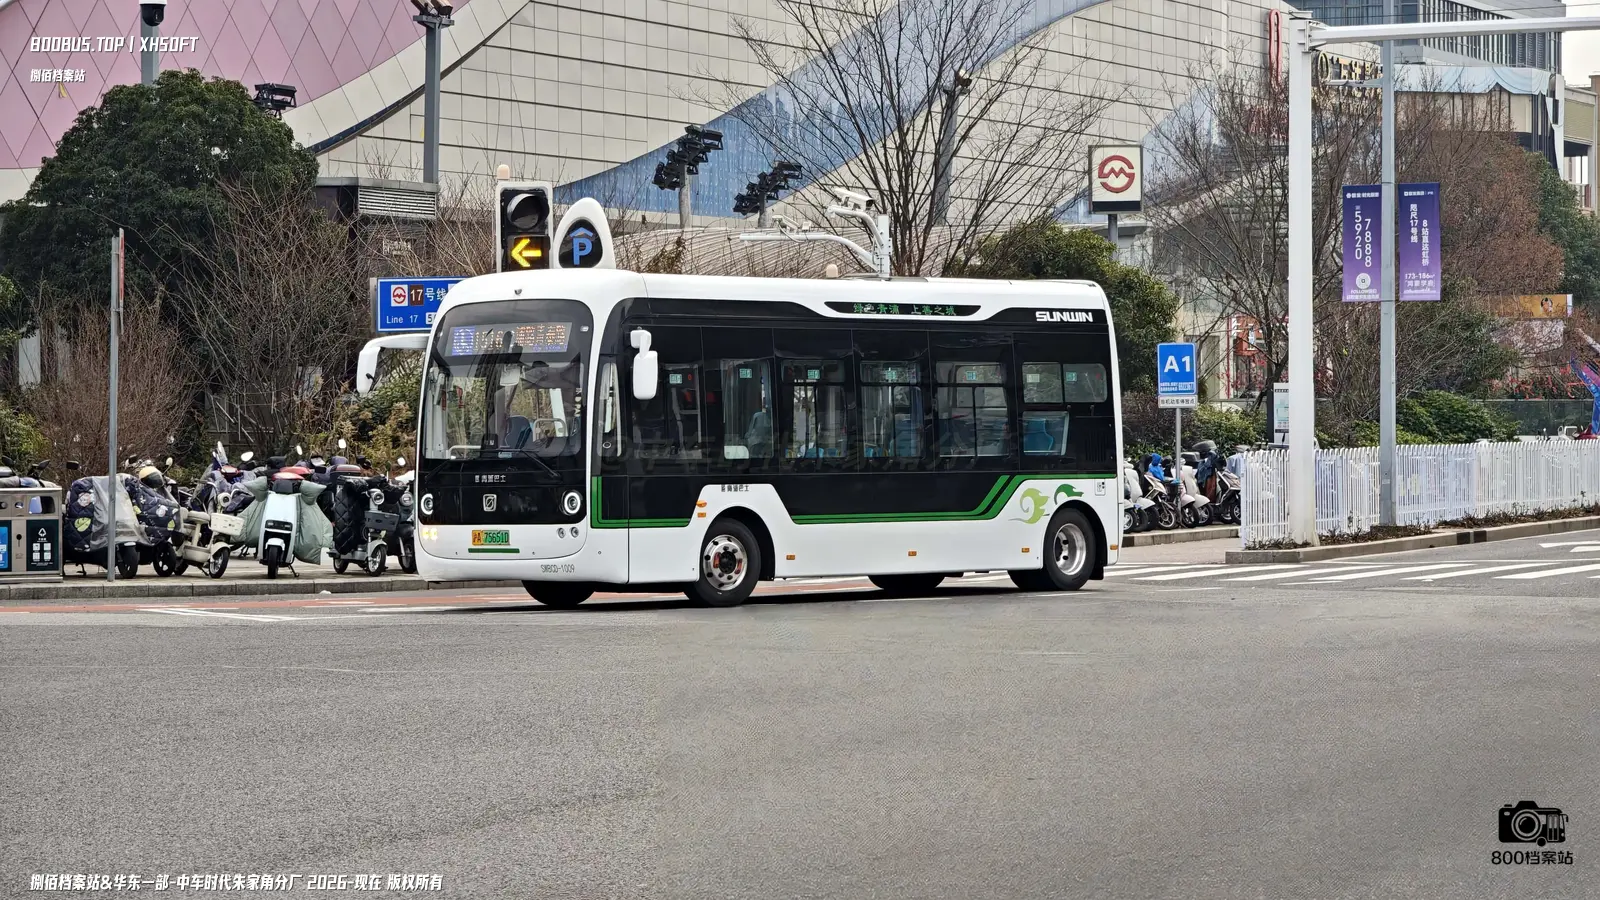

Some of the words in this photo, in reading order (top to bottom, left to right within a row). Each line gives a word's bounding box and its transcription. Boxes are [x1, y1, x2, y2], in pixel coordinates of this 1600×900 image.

[573, 237, 593, 266] P
[386, 315, 404, 324] Line
[409, 314, 418, 323] 17
[1035, 311, 1094, 322] SUNWIN
[1163, 355, 1191, 373] A1
